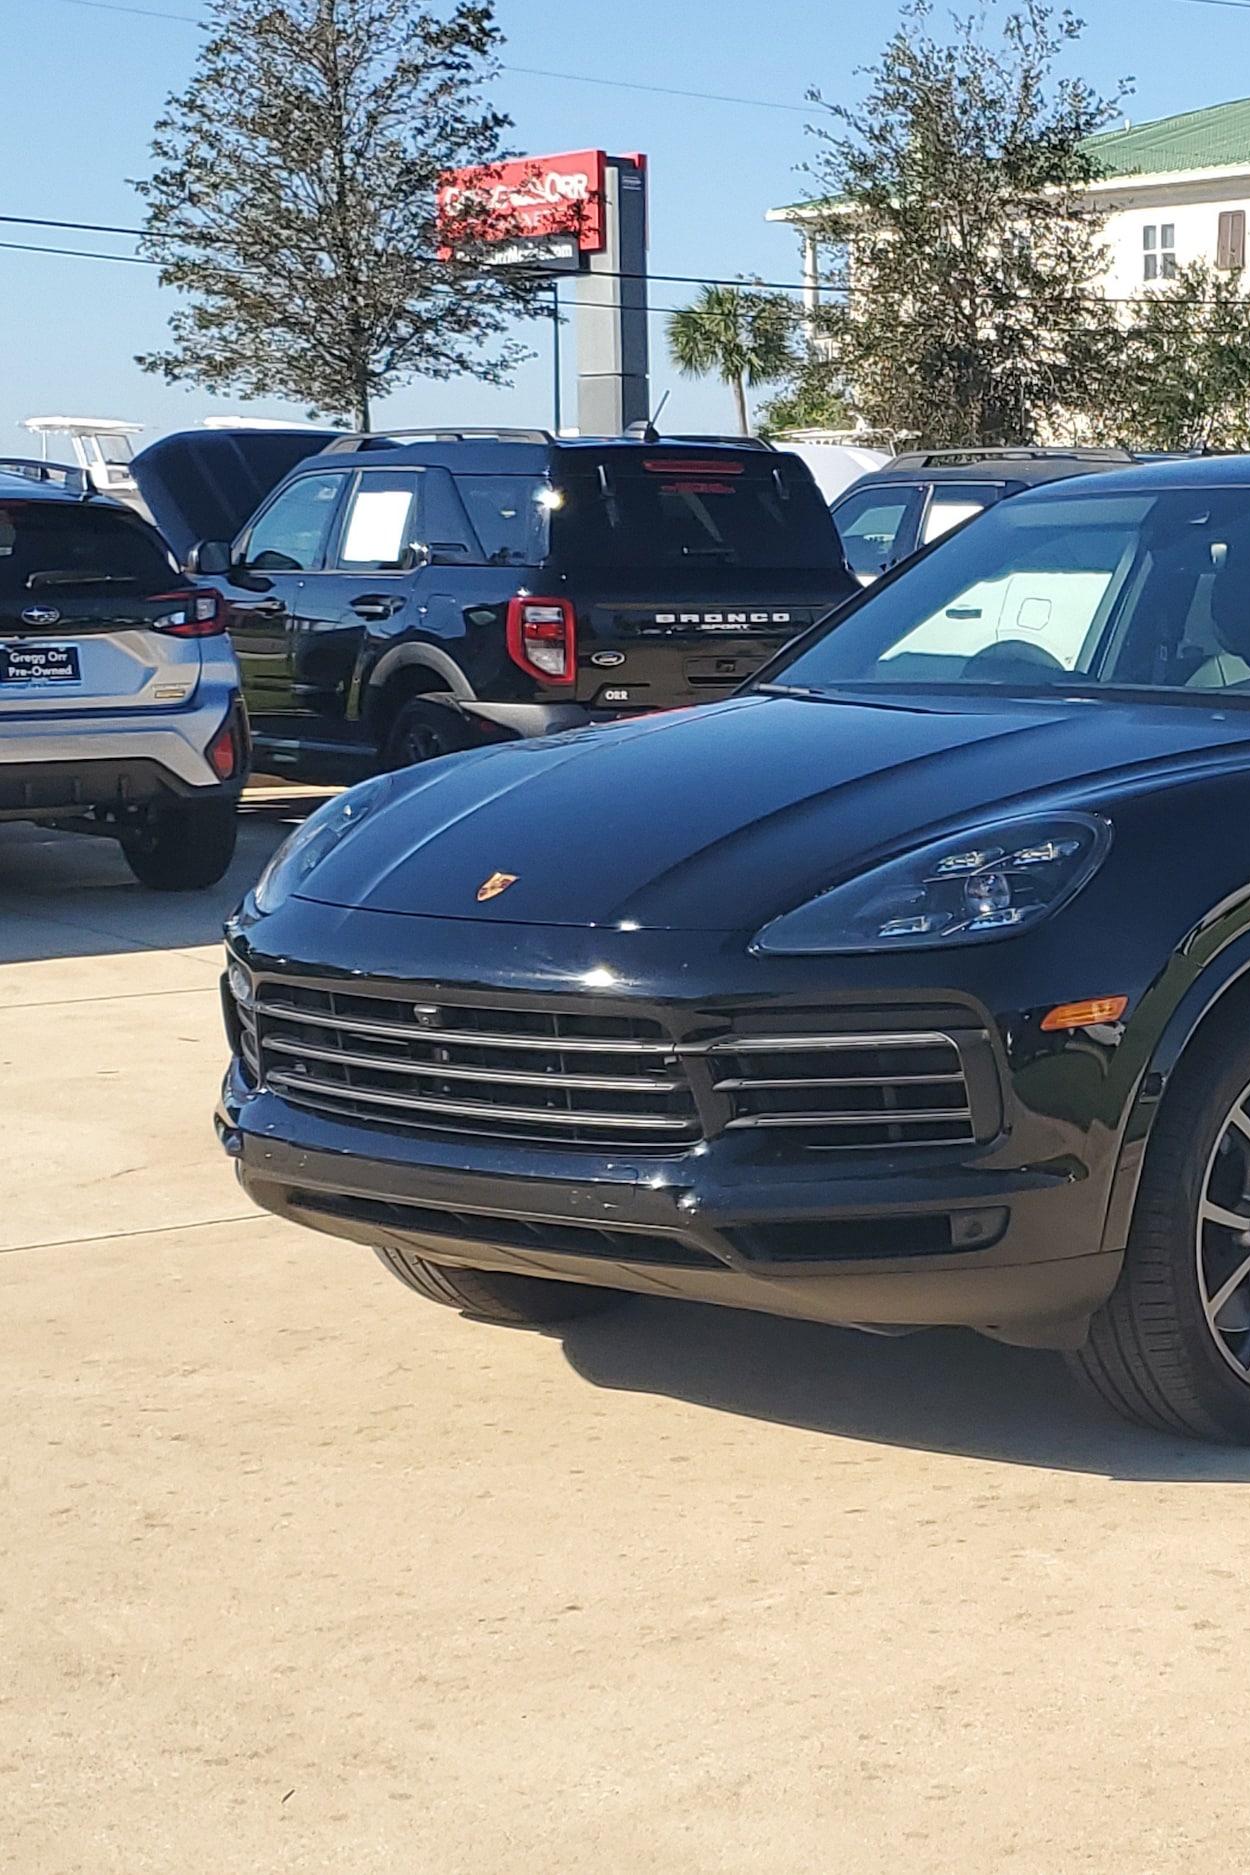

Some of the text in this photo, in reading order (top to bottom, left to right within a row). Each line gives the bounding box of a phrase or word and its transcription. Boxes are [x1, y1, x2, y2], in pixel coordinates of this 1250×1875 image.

[655, 612, 790, 624] BRONCO
[701, 623, 750, 631] SPORT
[9, 651, 68, 665] Gregg Orr
[8, 664, 73, 678] Pre-Owned
